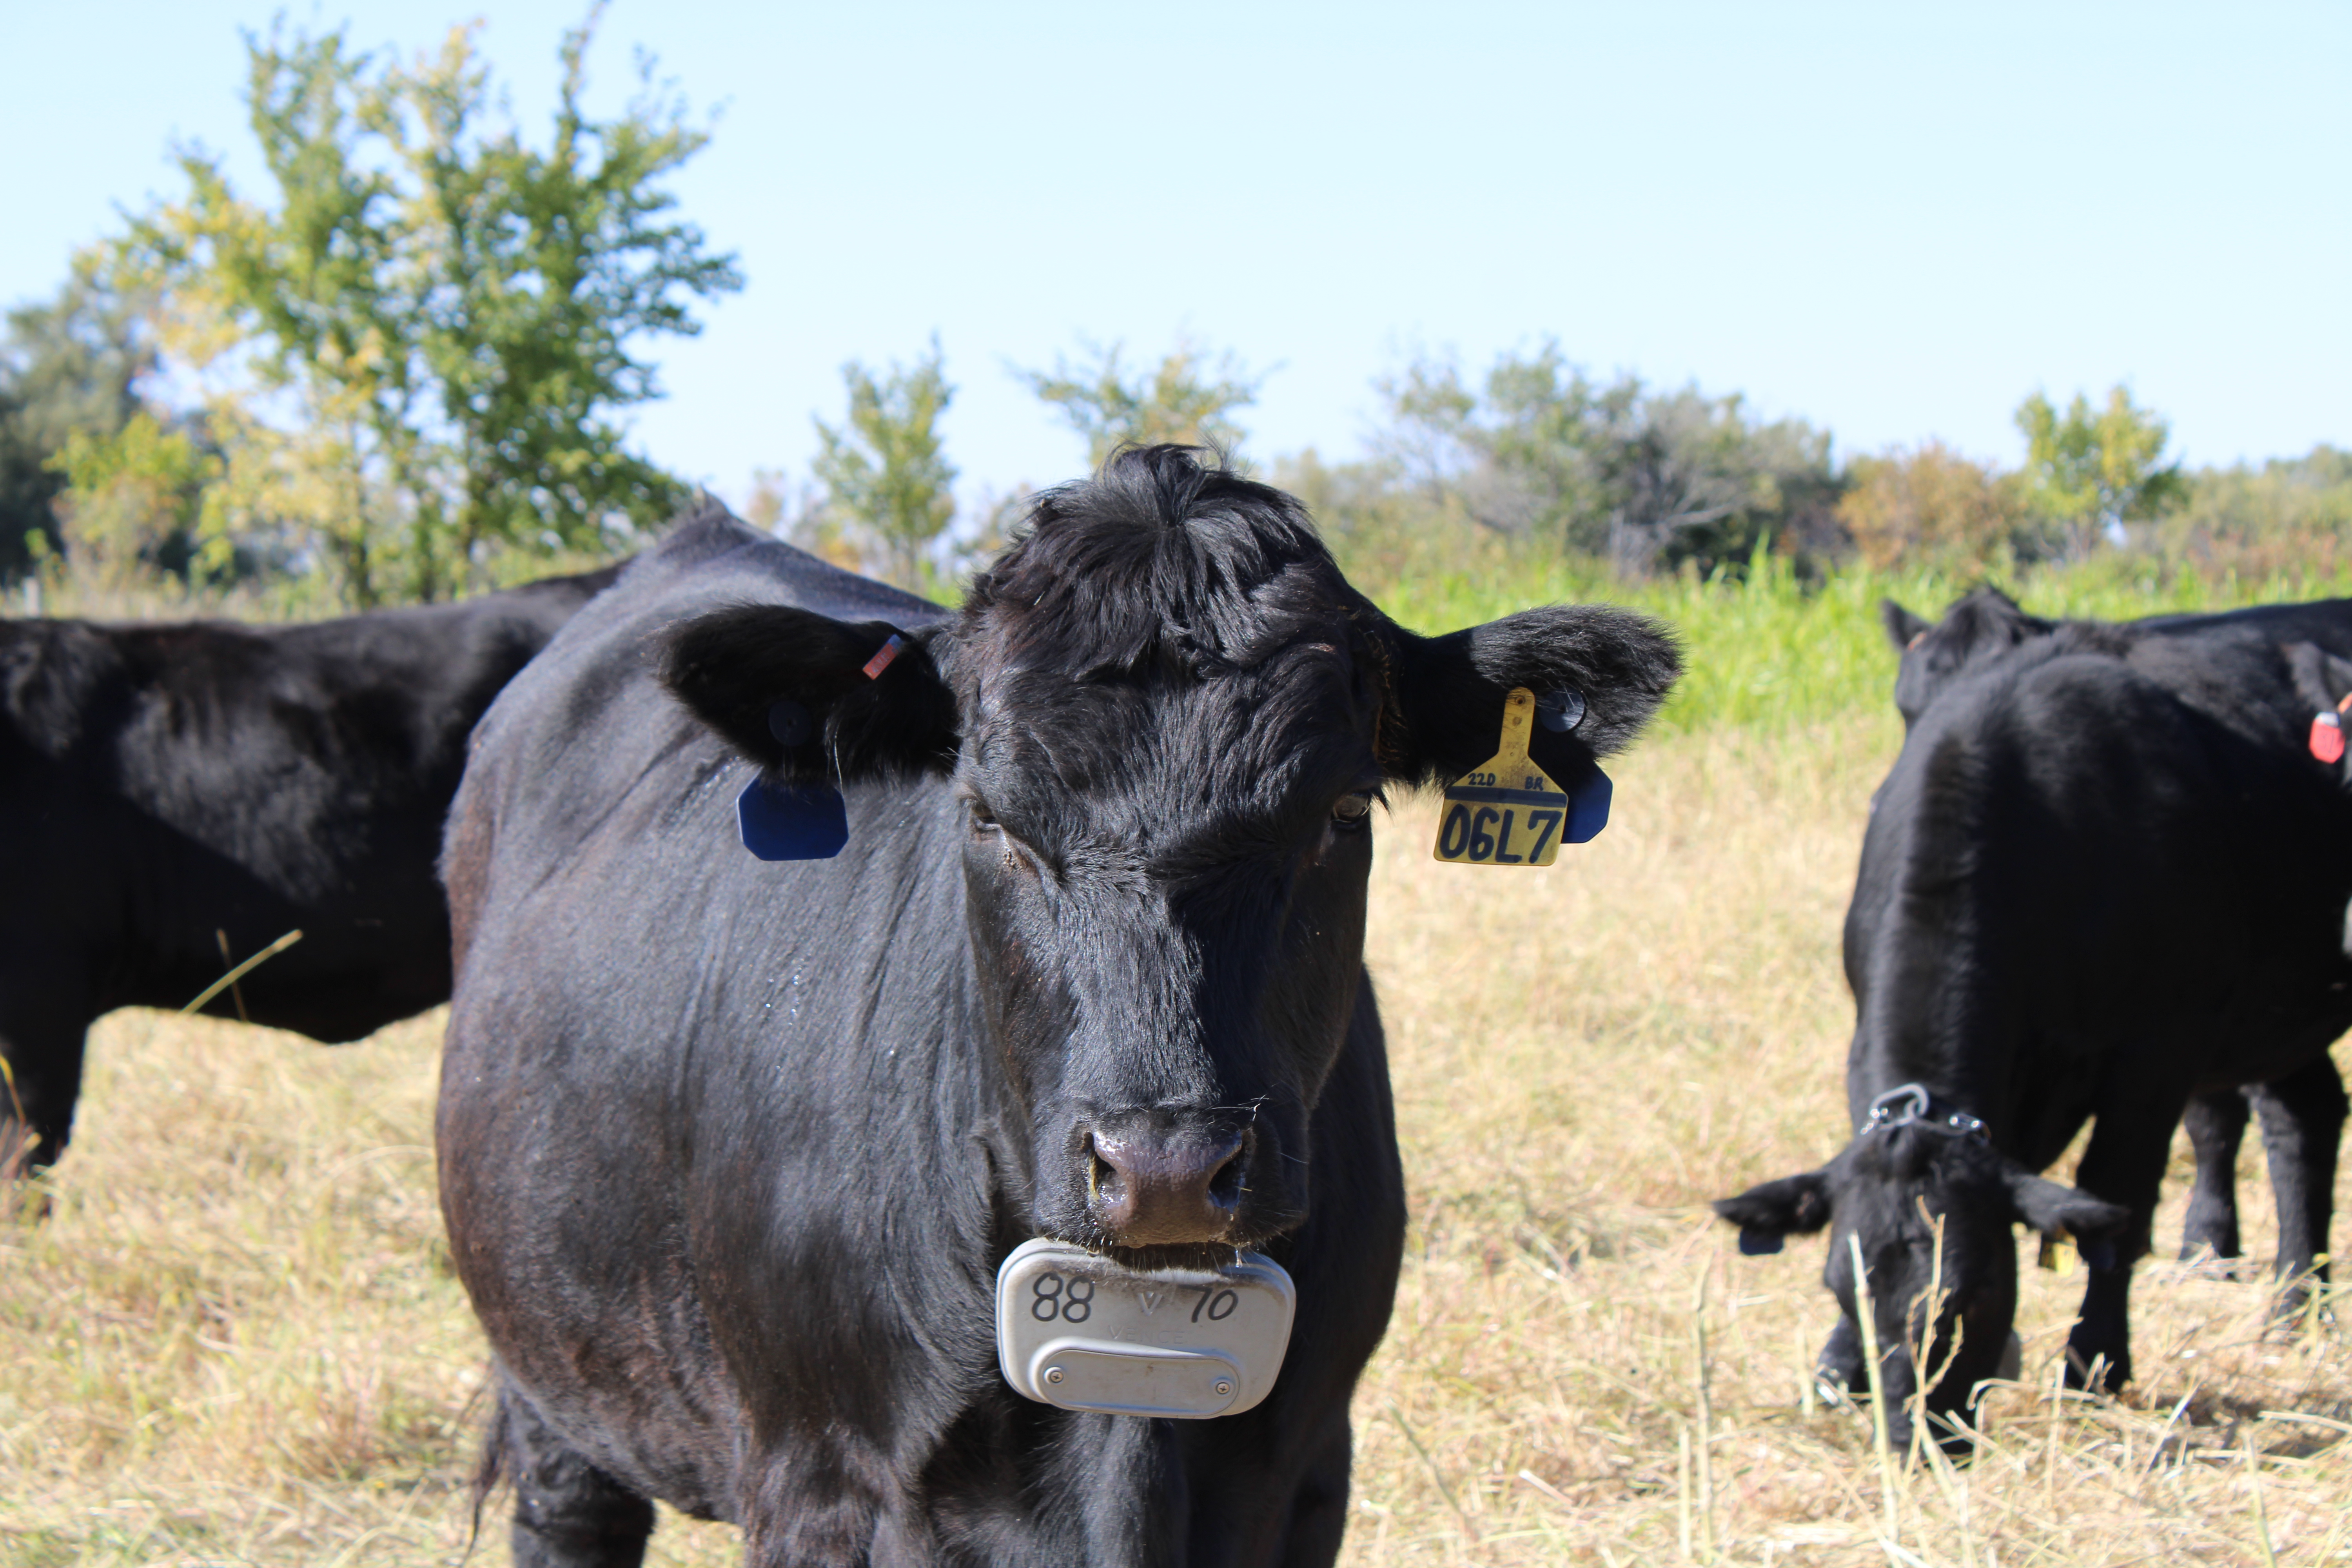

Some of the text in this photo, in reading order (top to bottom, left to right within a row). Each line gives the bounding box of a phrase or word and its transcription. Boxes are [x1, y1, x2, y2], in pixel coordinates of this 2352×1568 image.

[1524, 776, 1544, 791] BR
[1439, 803, 1563, 864] 06L7
[1031, 1272, 1239, 1323] 88 70
[1109, 1325, 1185, 1344] VENCE
